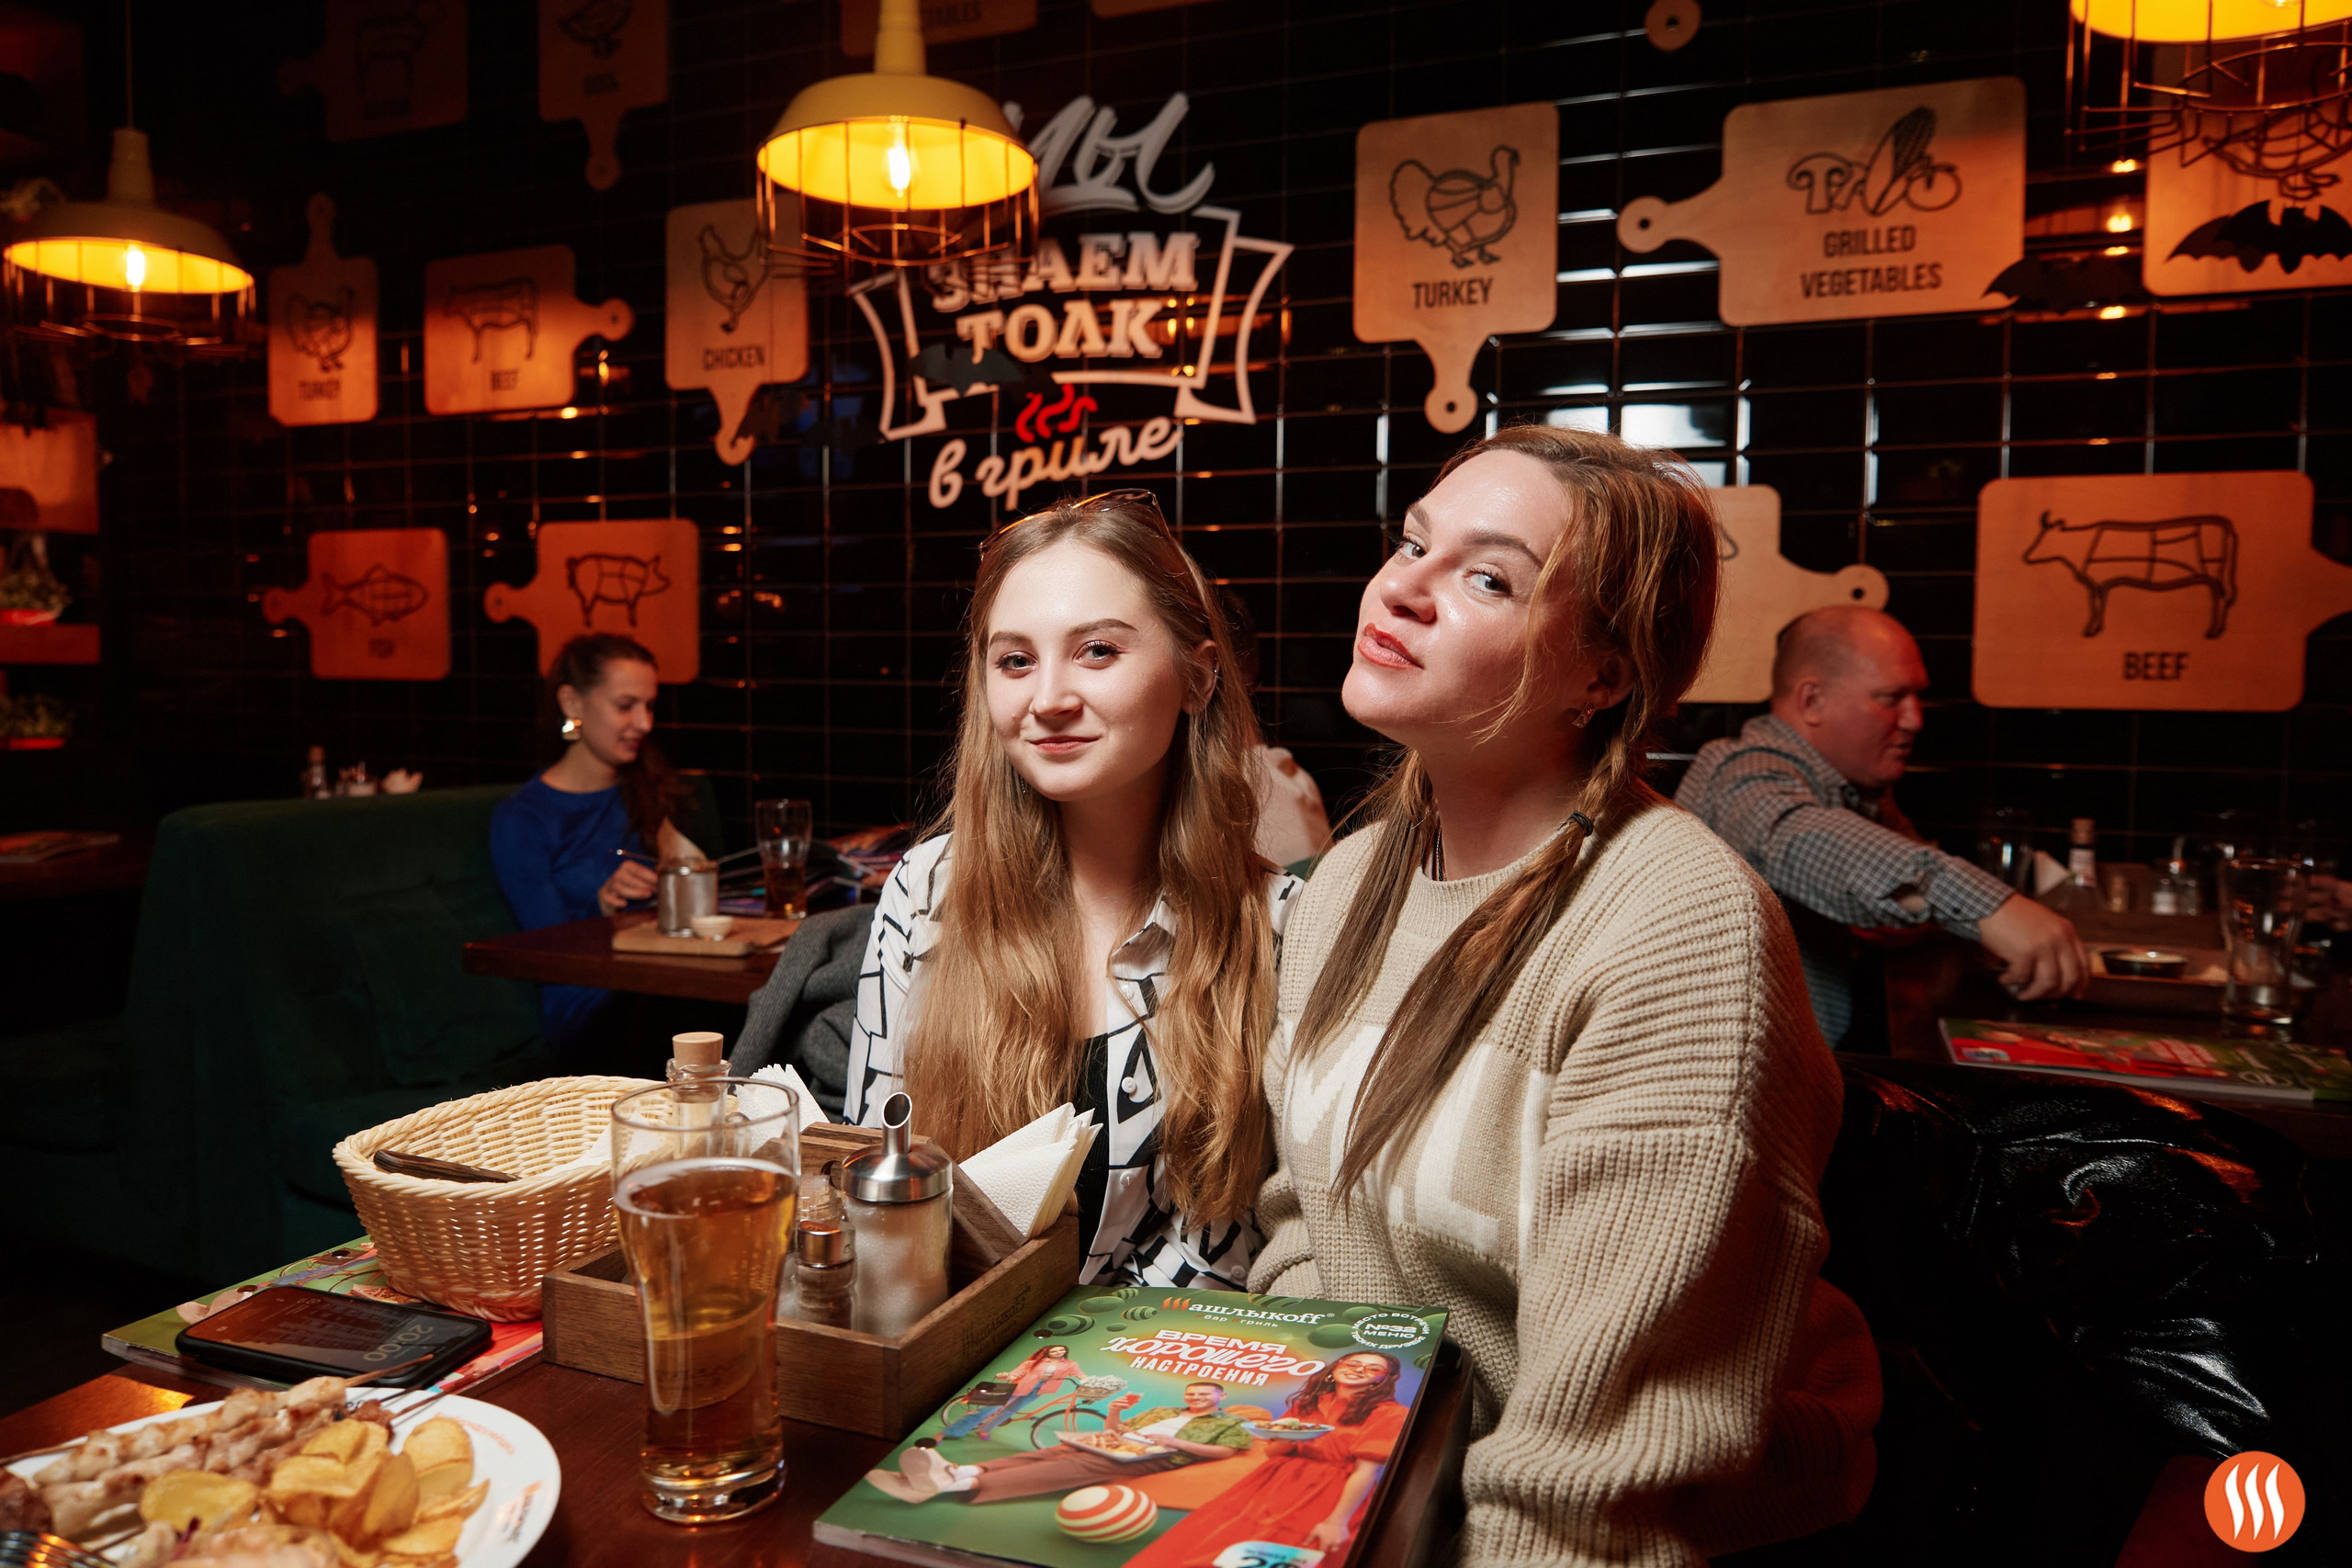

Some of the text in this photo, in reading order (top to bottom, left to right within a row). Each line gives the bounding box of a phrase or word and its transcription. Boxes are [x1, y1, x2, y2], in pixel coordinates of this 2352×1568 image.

[1825, 225, 1917, 258] GRILLED
[926, 230, 1200, 313] ЗНАЕМ
[1801, 262, 1942, 299] VEGETABLES
[1412, 277, 1494, 310] TURKEY
[955, 299, 1164, 364] ТОЛК
[703, 344, 764, 371] CHICKEN
[928, 415, 1184, 512] в гриле
[2123, 650, 2189, 681] BEEF
[363, 1324, 435, 1361] 20:00
[1155, 1329, 1287, 1355] ВРЕМЯ
[1363, 1330, 1415, 1338] МЕНЮ
[1129, 1356, 1270, 1387] НАСТРОЕНИЯ
